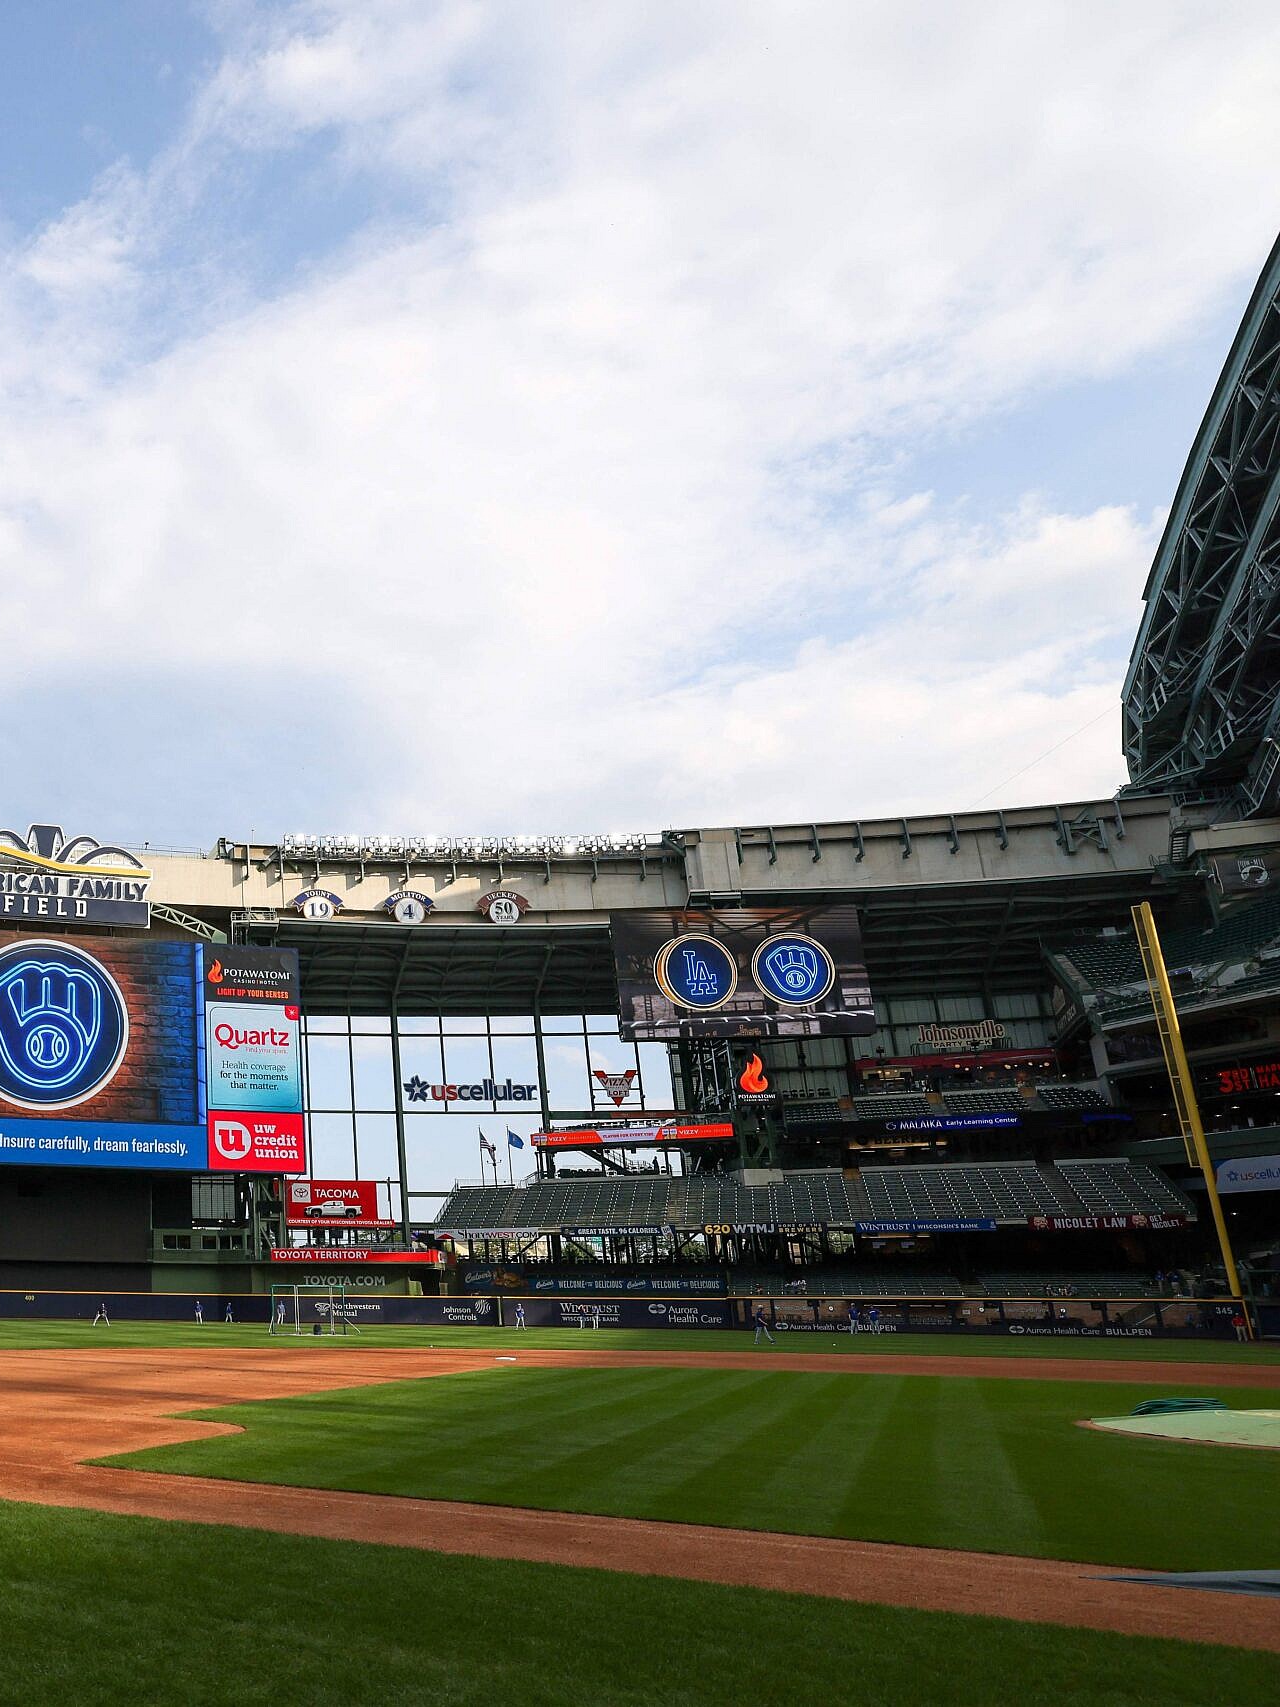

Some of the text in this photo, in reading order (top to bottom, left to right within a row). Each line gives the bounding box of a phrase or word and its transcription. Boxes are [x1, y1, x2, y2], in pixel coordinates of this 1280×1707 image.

[67, 878, 148, 901] FAMILY
[304, 889, 332, 899] YOUNT
[486, 890, 518, 900] UECKER
[391, 891, 427, 902] MOLITOR
[3, 895, 88, 917] FIELD
[308, 901, 329, 917] 19
[402, 904, 414, 918] 4
[494, 902, 513, 916] 50
[224, 967, 290, 980] POTAWATOMI
[217, 987, 235, 996] LIGHT
[247, 989, 264, 998] YOUR
[265, 990, 289, 999] SENSES
[215, 1023, 289, 1049] Quartz
[918, 1019, 1004, 1043] Johnsonville
[222, 1059, 286, 1072] Health coverage
[220, 1069, 288, 1081] for the moments
[230, 1080, 279, 1091] that matter.
[600, 1078, 632, 1087] VIZZY
[254, 1123, 276, 1133] uw
[899, 1116, 1018, 1130] MALAIKA Early Learning Center
[0, 1133, 189, 1155] Insure carefully, dream fearlessly.
[254, 1134, 297, 1146] credit
[254, 1147, 299, 1159] union
[314, 1188, 359, 1199] TACOMA
[704, 1223, 775, 1234] 620 WTMJ
[859, 1222, 911, 1231] WINTRUST
[1053, 1216, 1127, 1229] NICOLET LAW
[273, 1250, 369, 1260] TOYOTA TERRITORY
[304, 1274, 386, 1287] TOYOTA.COM
[332, 1302, 381, 1311] Northwestern
[442, 1306, 471, 1315] Johnson
[668, 1305, 699, 1314] Aurora
[448, 1313, 478, 1321] Controls
[668, 1314, 722, 1324] Health Care
[1025, 1327, 1152, 1336] Aurora Health Care BULLPEN
